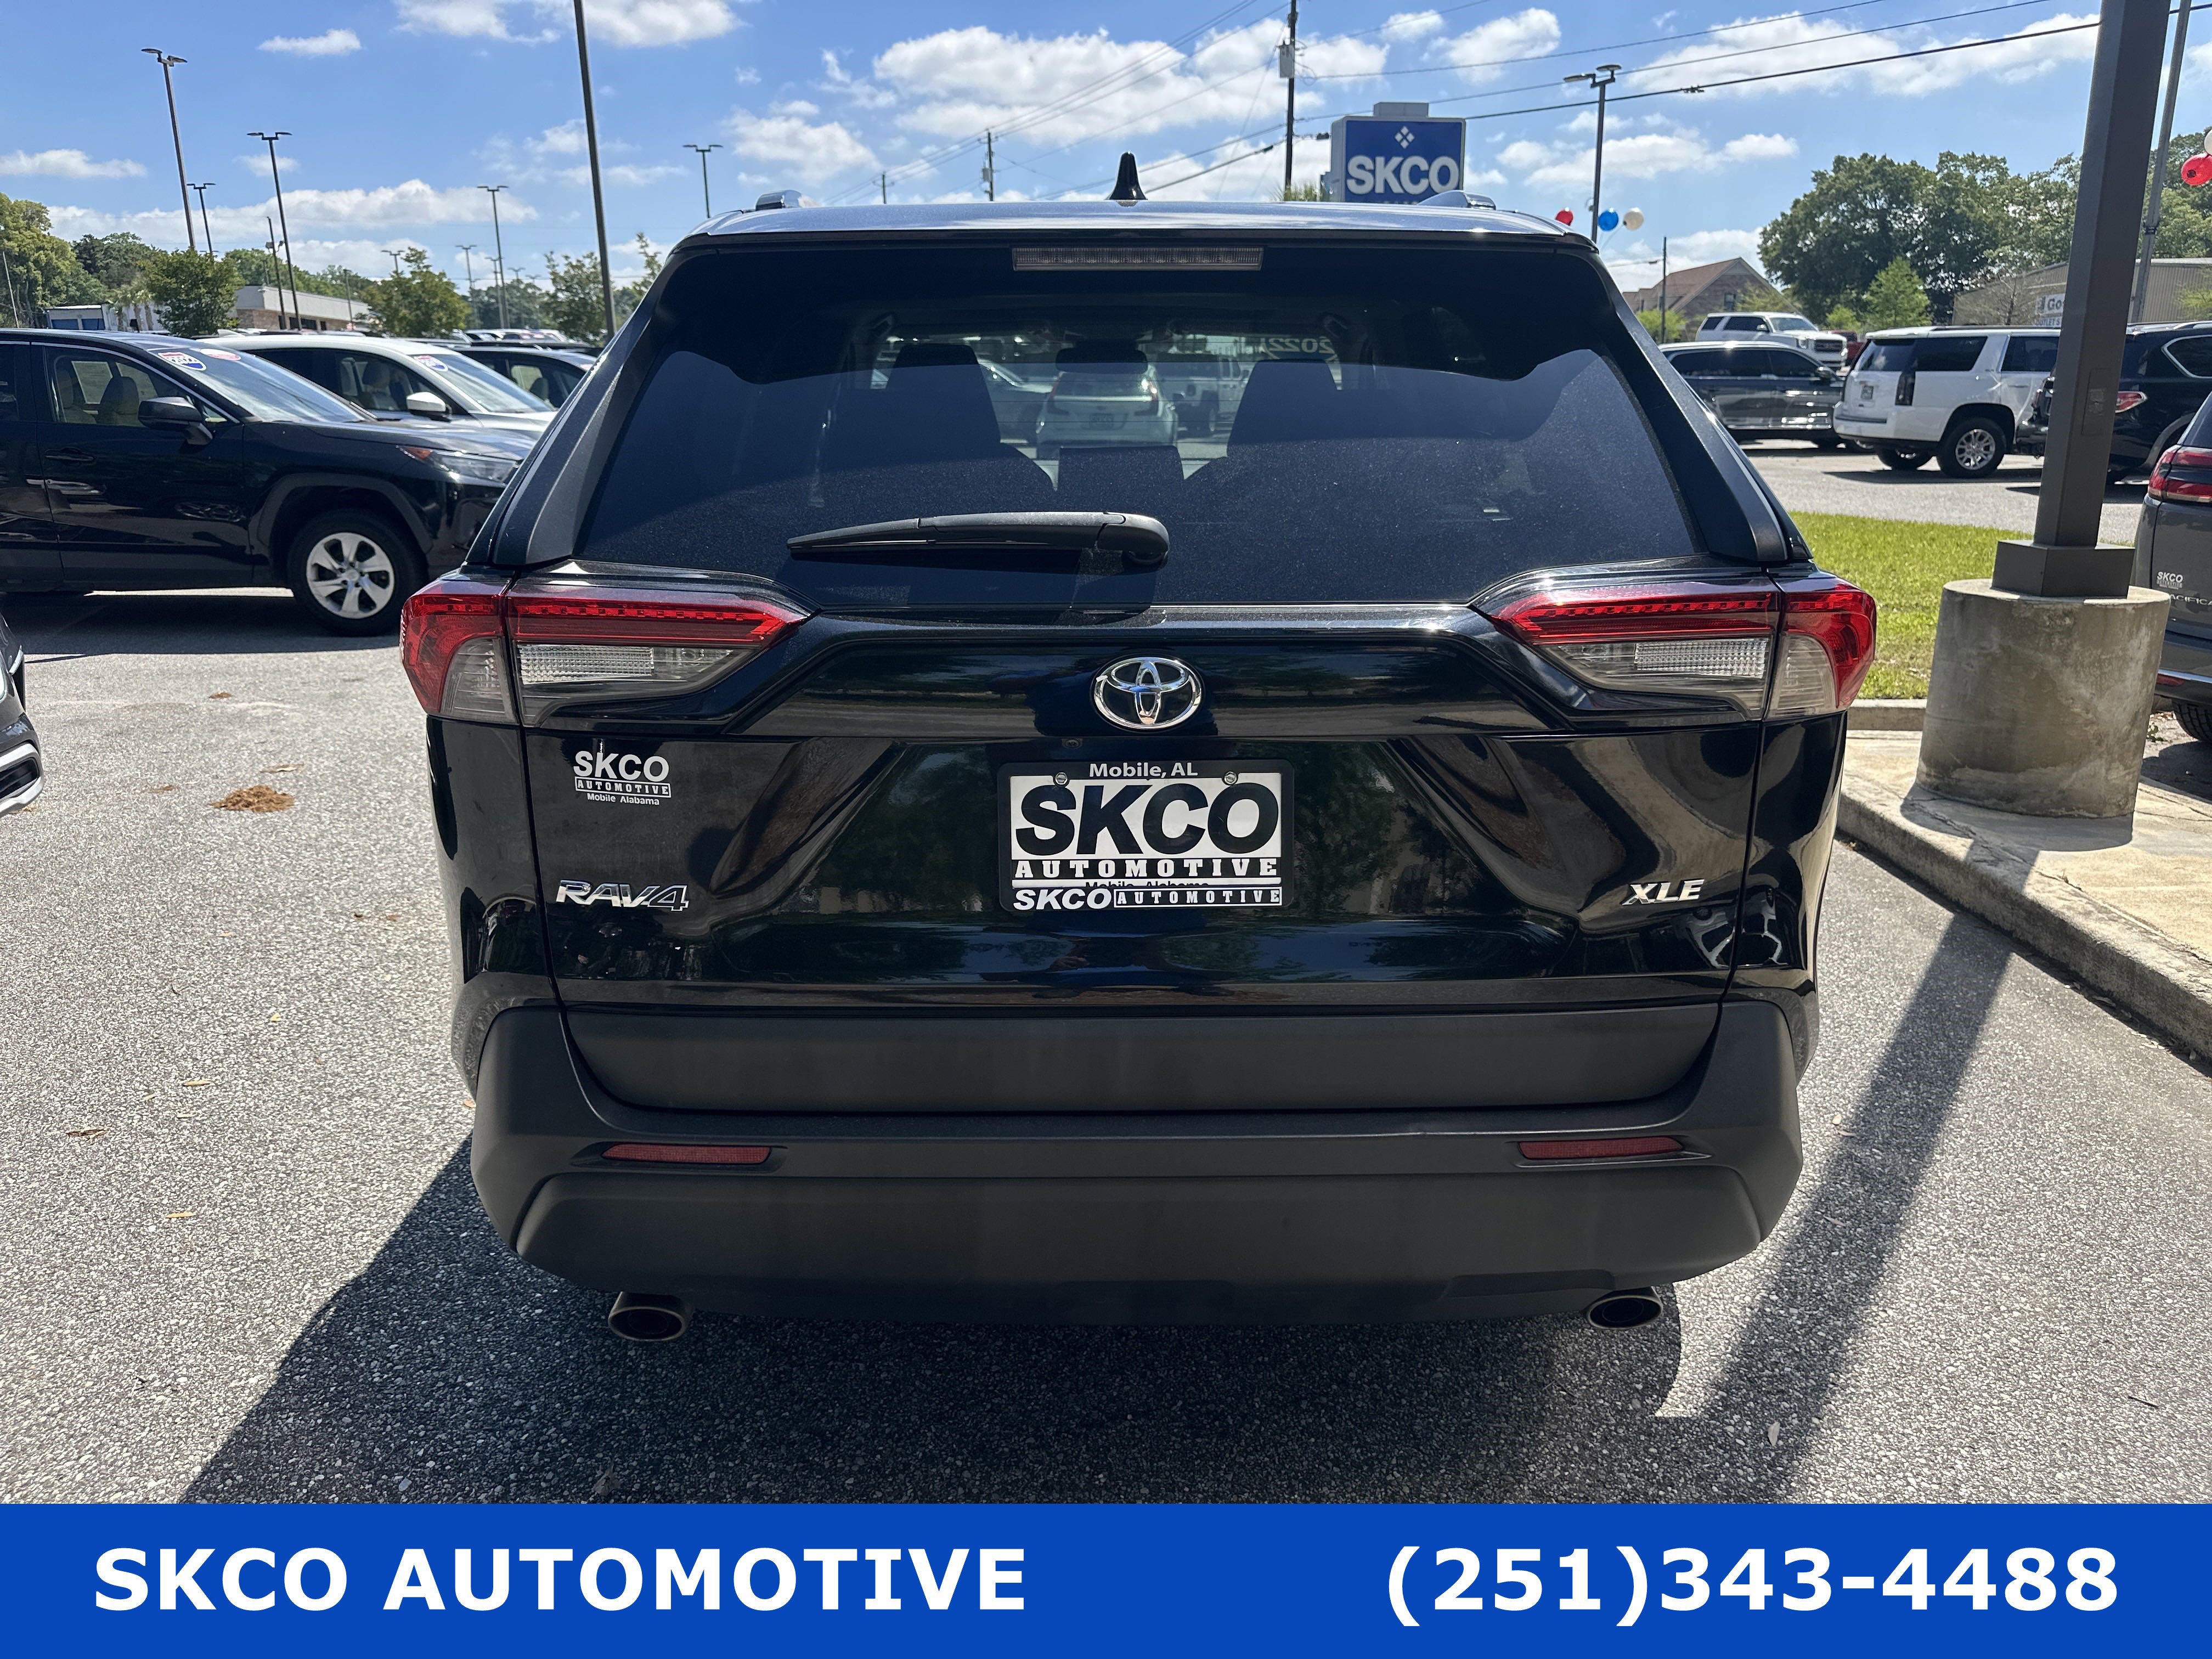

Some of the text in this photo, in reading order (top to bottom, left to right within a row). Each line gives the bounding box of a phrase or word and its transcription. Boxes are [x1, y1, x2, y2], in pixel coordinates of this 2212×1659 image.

[1346, 155, 1459, 195] SKCO
[2047, 298, 2063, 311] Go
[2157, 571, 2183, 583] SKCO
[573, 751, 670, 782] SKCO
[1089, 762, 1198, 778] Mobile, AL
[577, 779, 669, 795] AUTOMOTIVE
[587, 793, 660, 805] Mobile Alabama
[1015, 783, 1279, 856] SKCO
[1015, 857, 1278, 878] AUTOMOTIVE
[555, 879, 690, 912] RAV4
[1013, 888, 1280, 910] SKCO AUTOMOTIVE
[1621, 879, 1705, 906] XLE
